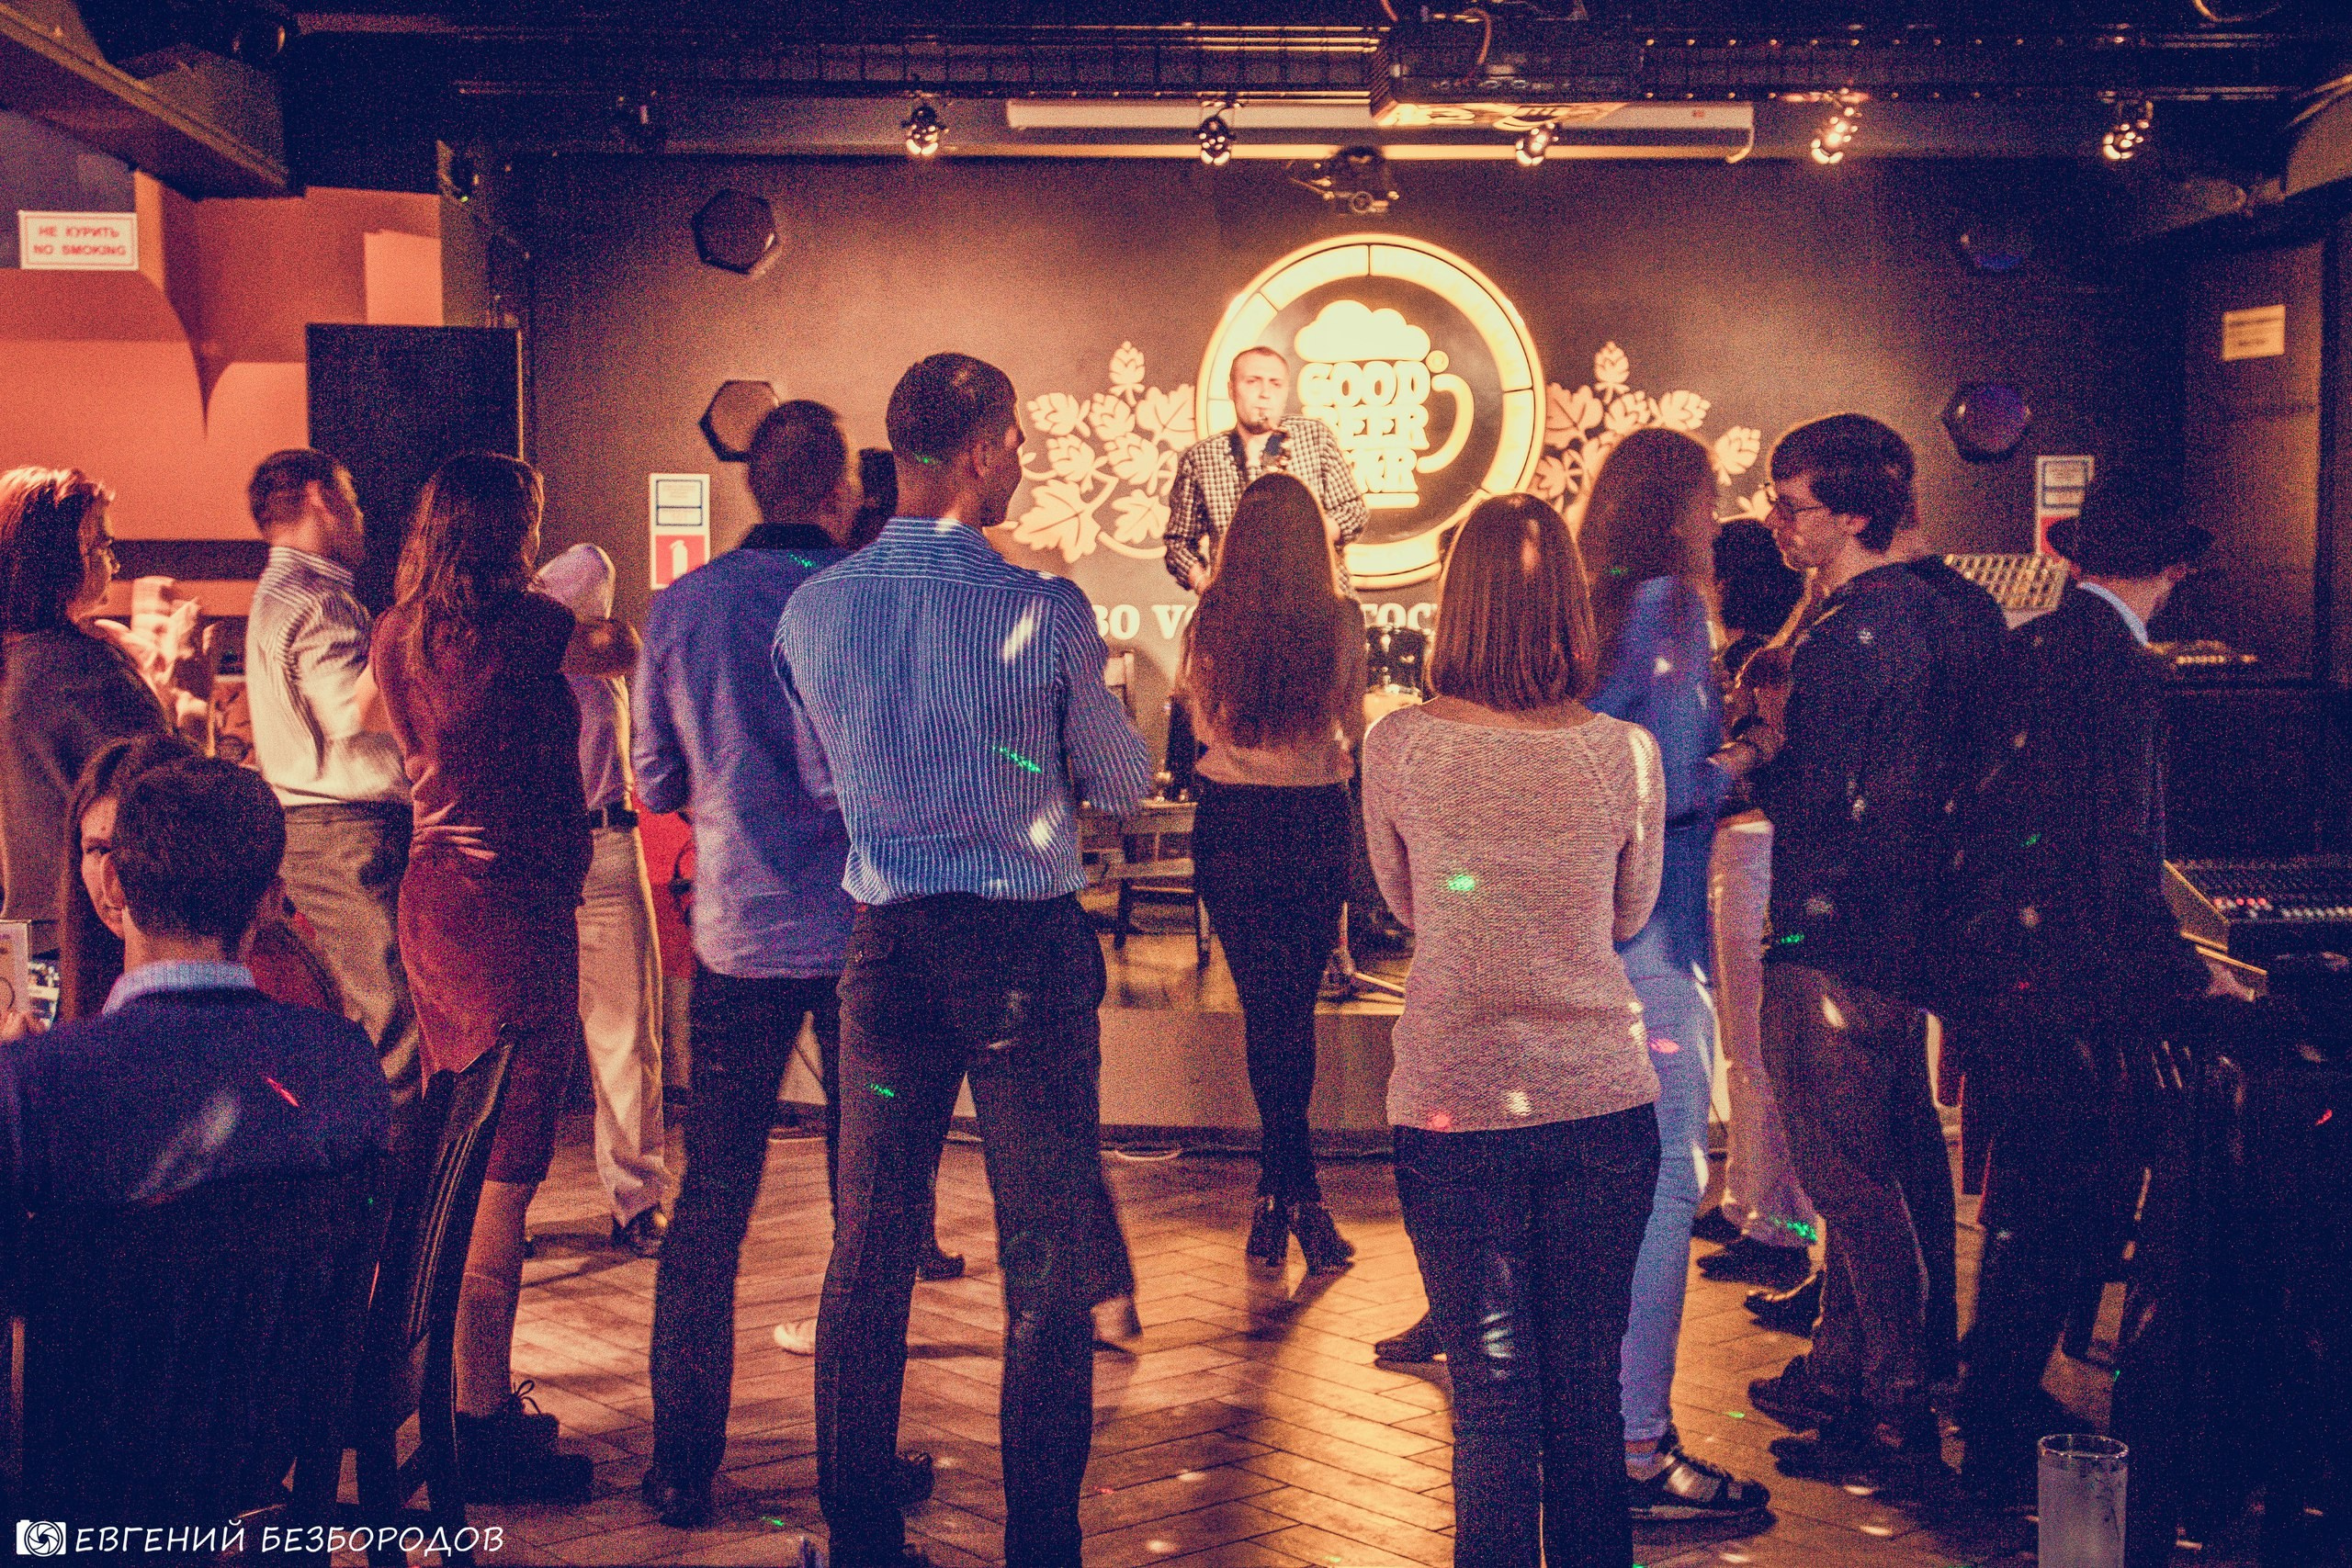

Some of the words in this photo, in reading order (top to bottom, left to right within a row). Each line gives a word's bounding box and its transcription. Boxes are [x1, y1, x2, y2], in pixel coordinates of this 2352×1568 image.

[39, 226, 57, 237] НЕ
[65, 226, 119, 238] КУРИТЬ
[33, 244, 54, 255] NO
[62, 244, 127, 256] SMOKING
[1297, 361, 1430, 407] GOOD
